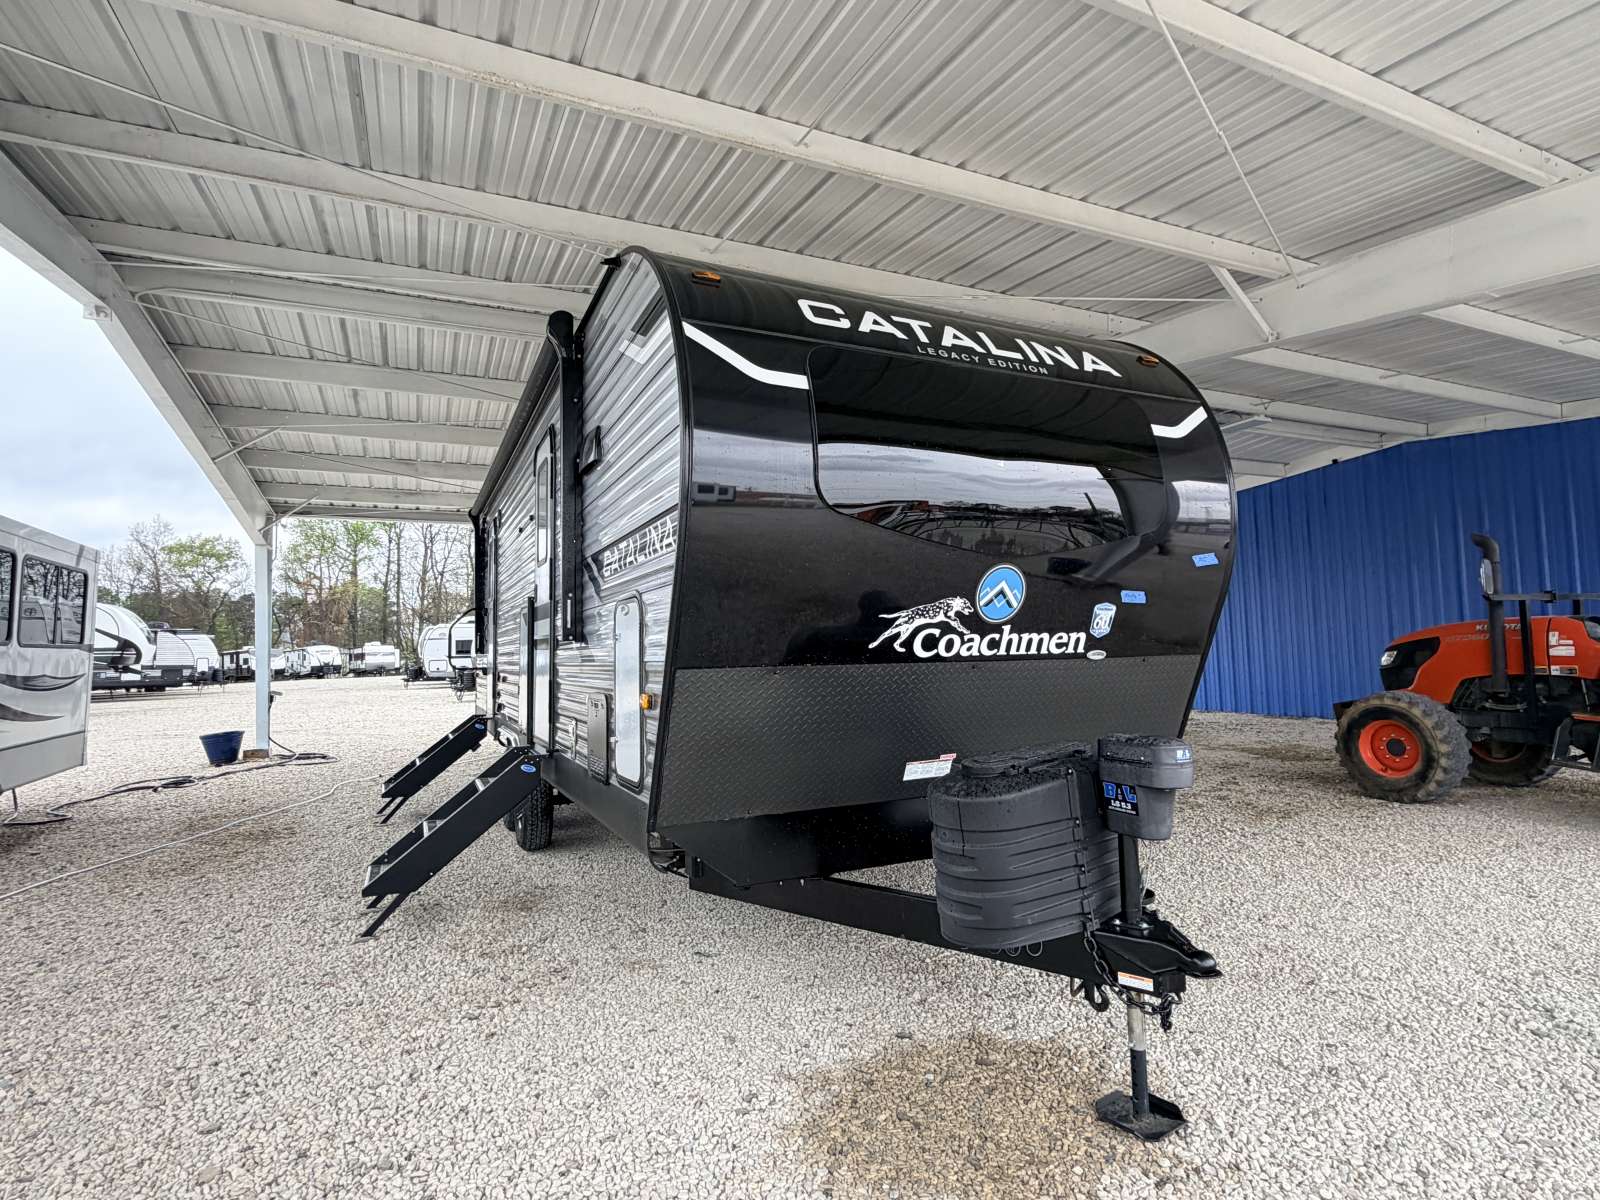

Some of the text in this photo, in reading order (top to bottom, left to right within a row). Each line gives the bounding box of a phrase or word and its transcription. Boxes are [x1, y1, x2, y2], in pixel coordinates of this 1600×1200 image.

[797, 298, 1122, 378] CATALINA
[916, 345, 1049, 375] LEGACY EDITION
[603, 515, 677, 578] CATALINA
[913, 625, 1087, 658] Coachmen
